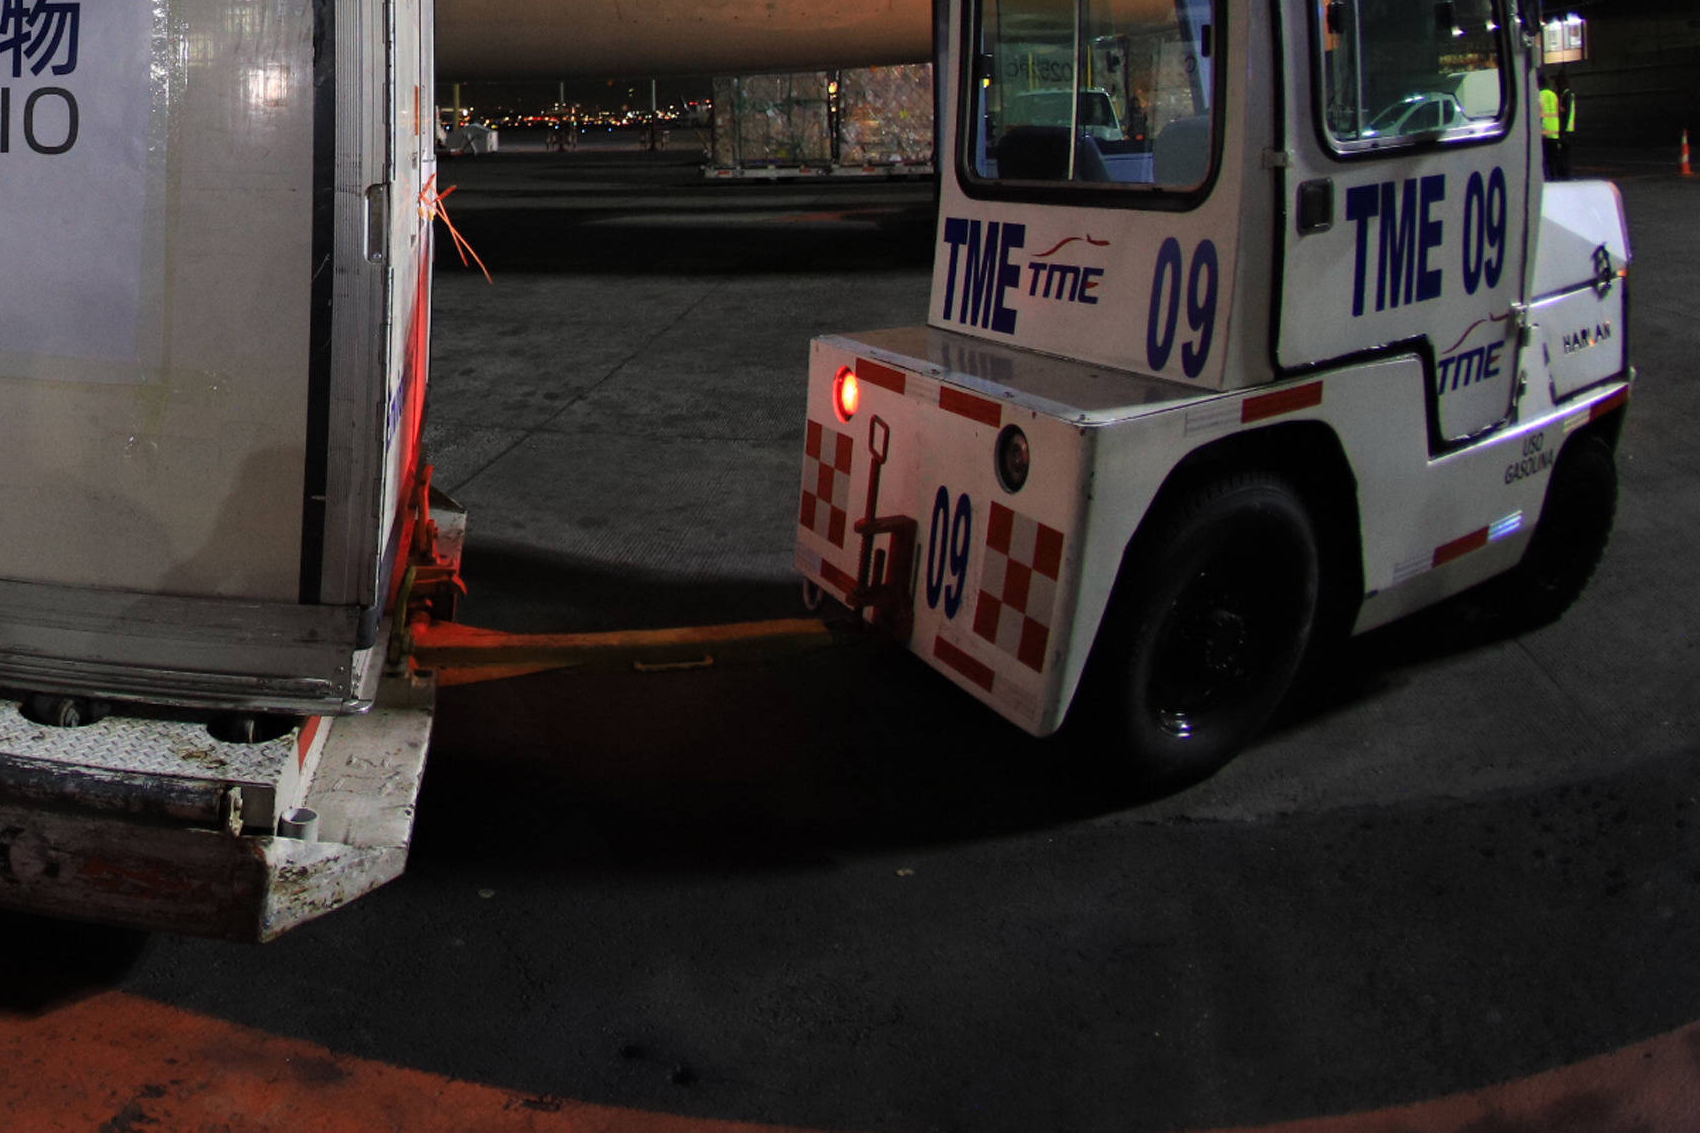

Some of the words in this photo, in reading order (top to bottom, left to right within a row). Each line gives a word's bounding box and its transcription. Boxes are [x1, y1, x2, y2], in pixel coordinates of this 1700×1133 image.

[943, 216, 1026, 335] TME
[1028, 261, 1104, 304] TME
[1346, 174, 1446, 317] TME
[1462, 165, 1507, 296] 09
[1146, 236, 1219, 379] 09
[1562, 319, 1612, 355] HARLAN
[1438, 340, 1505, 395] TME
[1522, 432, 1544, 457] USO
[927, 485, 973, 621] 09
